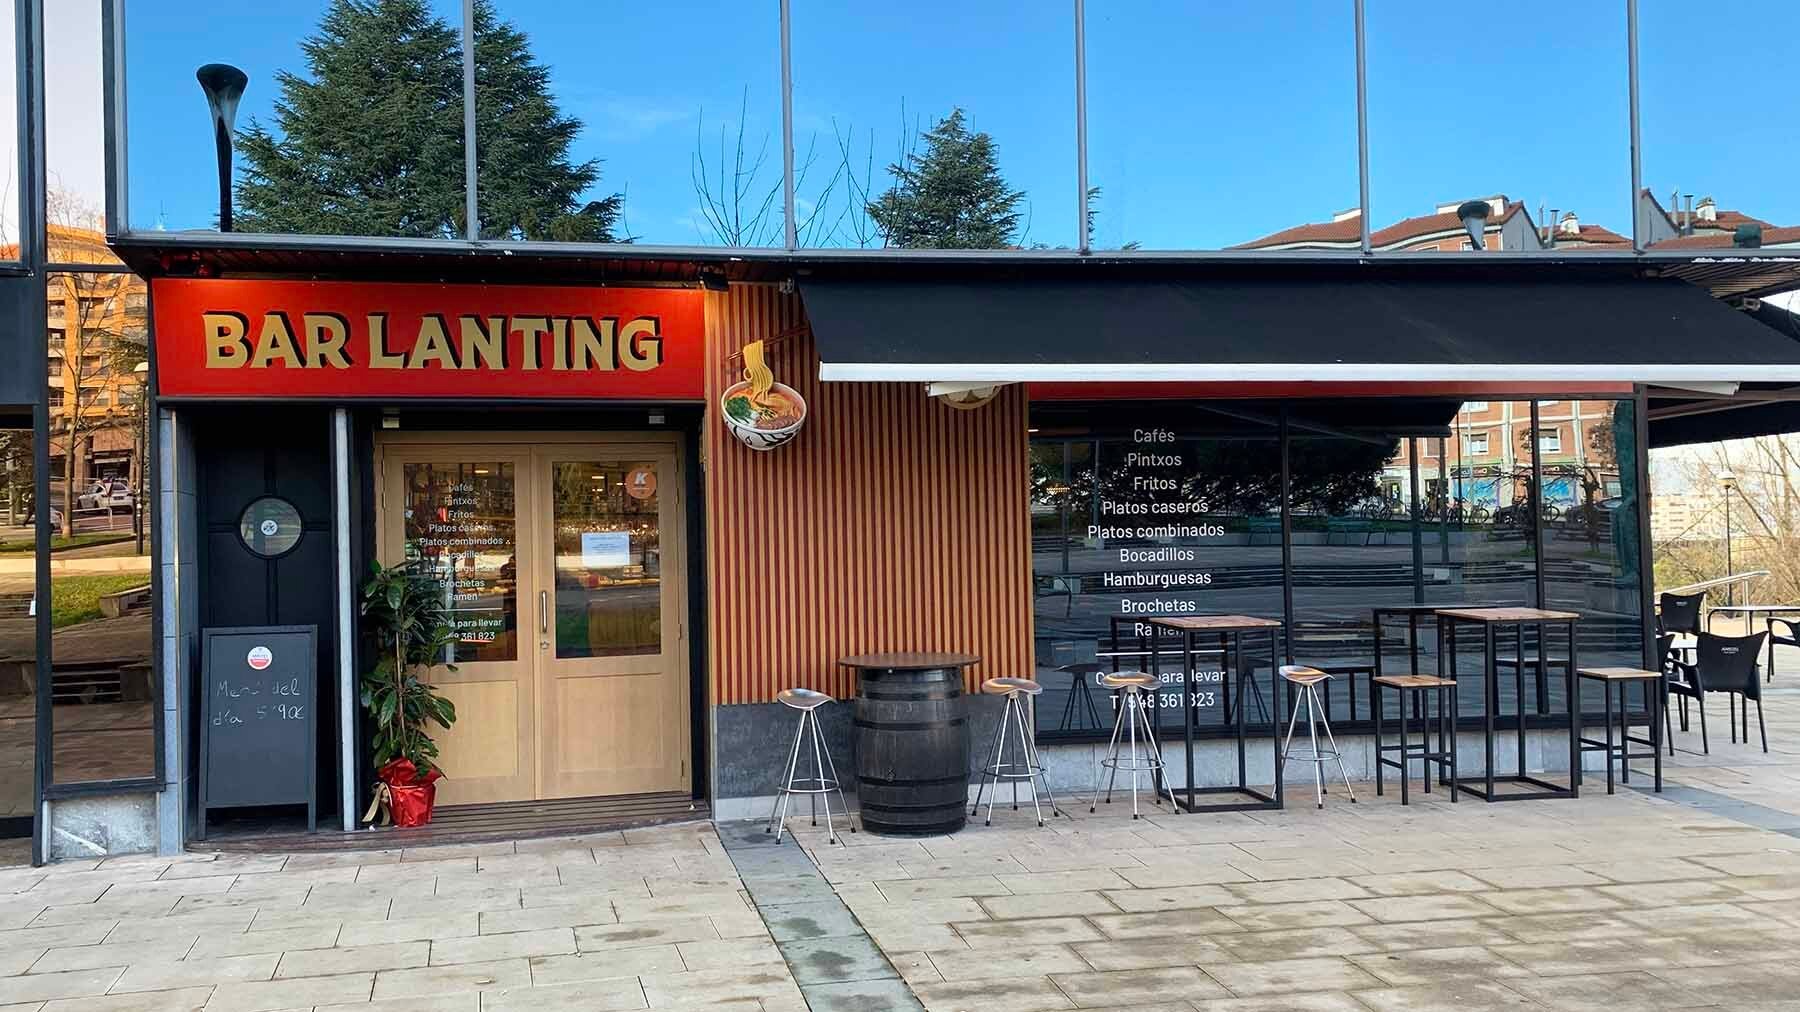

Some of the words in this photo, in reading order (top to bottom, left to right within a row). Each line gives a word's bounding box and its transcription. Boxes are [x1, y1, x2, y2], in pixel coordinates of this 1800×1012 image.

[202, 311, 350, 369] BAR
[367, 312, 662, 371] LANTING
[1134, 428, 1175, 443] Cafés
[1128, 453, 1182, 467] Pintxos
[1134, 476, 1177, 491] Fritos
[448, 510, 474, 519] Fritos
[1103, 501, 1148, 515] Platos
[1151, 502, 1209, 514] caseros
[429, 524, 457, 533] Platos
[1087, 525, 1133, 539] Platos
[1137, 523, 1225, 538] combinados
[419, 538, 448, 546] Platos
[449, 537, 503, 546] combinados
[1120, 548, 1194, 562] Bocadillos
[440, 580, 485, 588] Brochetas
[1104, 572, 1212, 588] Hamburguesas
[1121, 598, 1196, 613] Brochetas
[458, 620, 477, 629] para
[479, 618, 503, 627] llevar
[478, 631, 495, 640] 823
[1191, 669, 1226, 682] levar
[1160, 693, 1183, 708] 361
